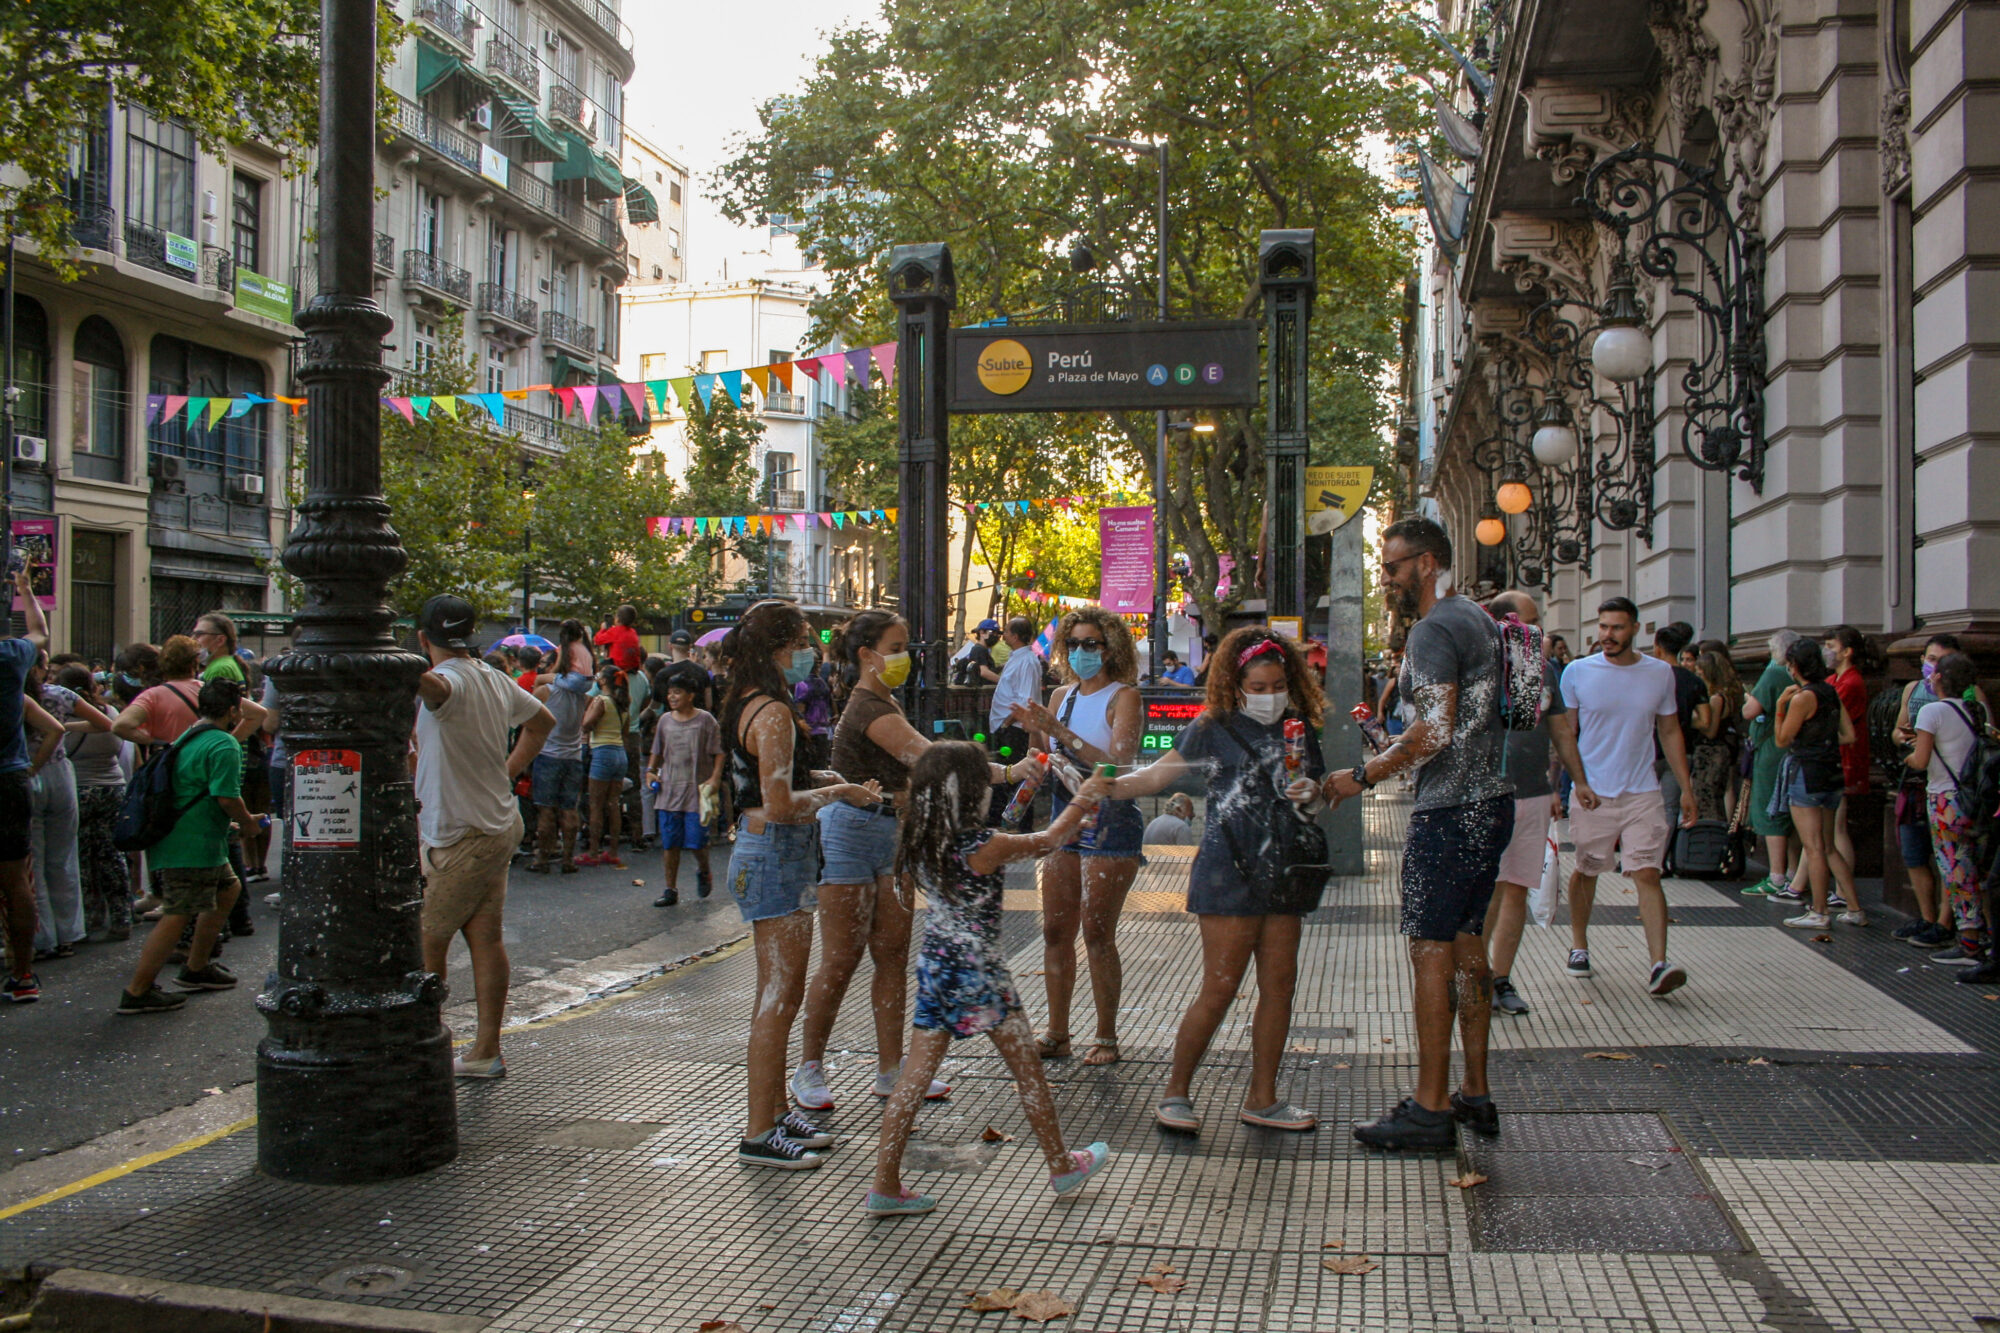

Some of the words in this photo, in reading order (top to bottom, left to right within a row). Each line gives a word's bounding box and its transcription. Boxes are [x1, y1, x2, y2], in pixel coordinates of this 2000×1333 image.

[266, 282, 287, 295] VENDE
[263, 291, 289, 305] ALQUILA
[985, 358, 1024, 371] Subte
[1048, 350, 1092, 369] Perú
[1048, 374, 1055, 383] a
[1058, 373, 1088, 383] Plaza
[1090, 372, 1104, 382] de
[1107, 372, 1139, 384] Mayo
[1151, 369, 1164, 381] A
[1180, 368, 1192, 381] D
[1208, 367, 1217, 380] E
[1325, 471, 1335, 479] DE
[1337, 471, 1361, 479] SUBTE
[1308, 479, 1361, 487] MONITOREADA
[1148, 723, 1176, 731] Estado
